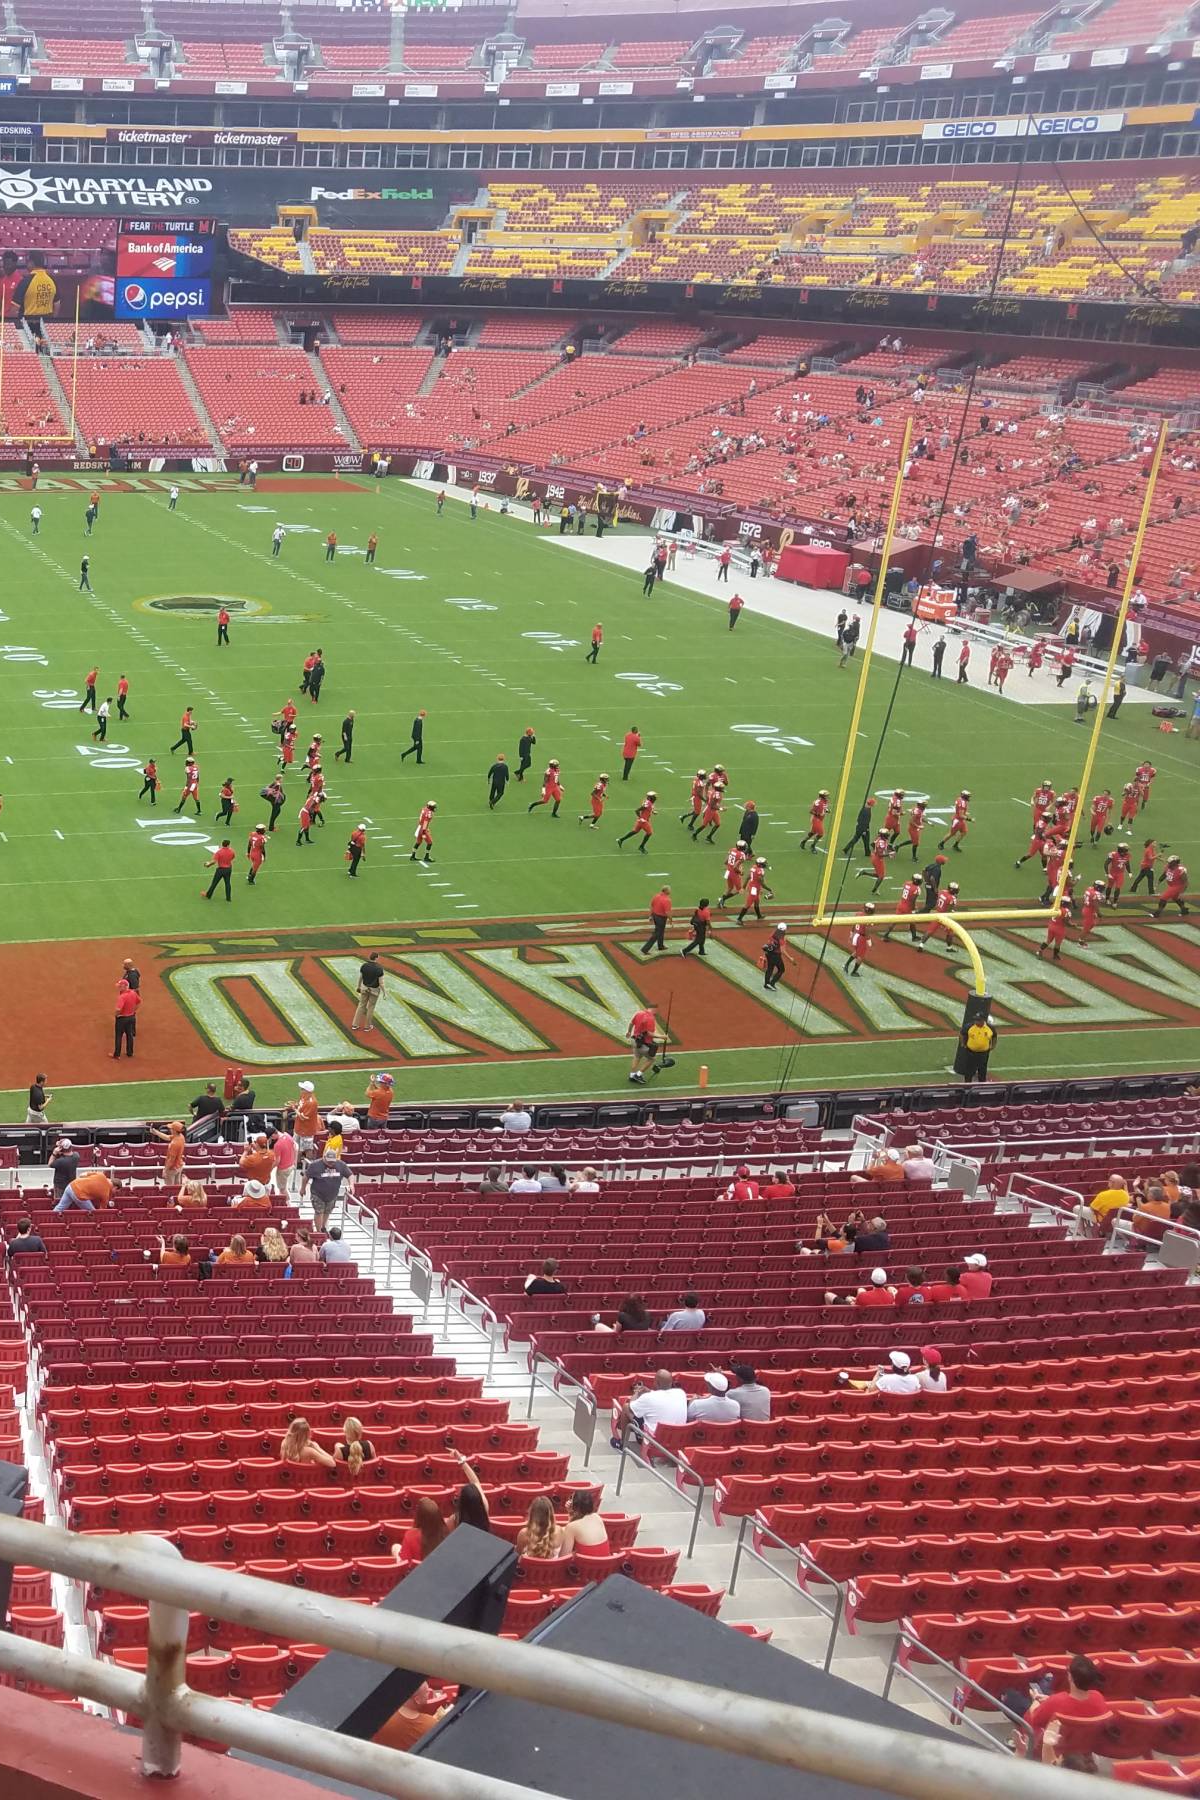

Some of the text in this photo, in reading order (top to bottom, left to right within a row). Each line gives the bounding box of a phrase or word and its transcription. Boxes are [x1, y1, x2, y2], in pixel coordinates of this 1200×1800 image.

[942, 122, 997, 137] GEICO
[1038, 117, 1099, 133] GEICO
[118, 130, 189, 144] ticketmaster
[214, 132, 284, 145] ticketmaster
[53, 176, 213, 193] MARYLAND
[58, 190, 186, 207] LOTTERY
[310, 186, 433, 201] FedExField
[127, 243, 153, 254] Bank
[164, 243, 204, 255] America
[150, 288, 202, 310] pepsi
[286, 458, 301, 468] 40
[333, 454, 364, 468] WOW!
[478, 470, 497, 484] 1937
[545, 484, 565, 499] 1942
[738, 521, 762, 538] 1972
[446, 598, 499, 612] 50
[520, 631, 583, 647] 40
[614, 672, 684, 691] 30
[32, 689, 85, 709] 30
[728, 724, 815, 747] 20
[75, 743, 142, 769] 20
[135, 815, 212, 846] 10
[728, 854, 736, 866] 83
[166, 924, 1200, 1065] ARYLAND
